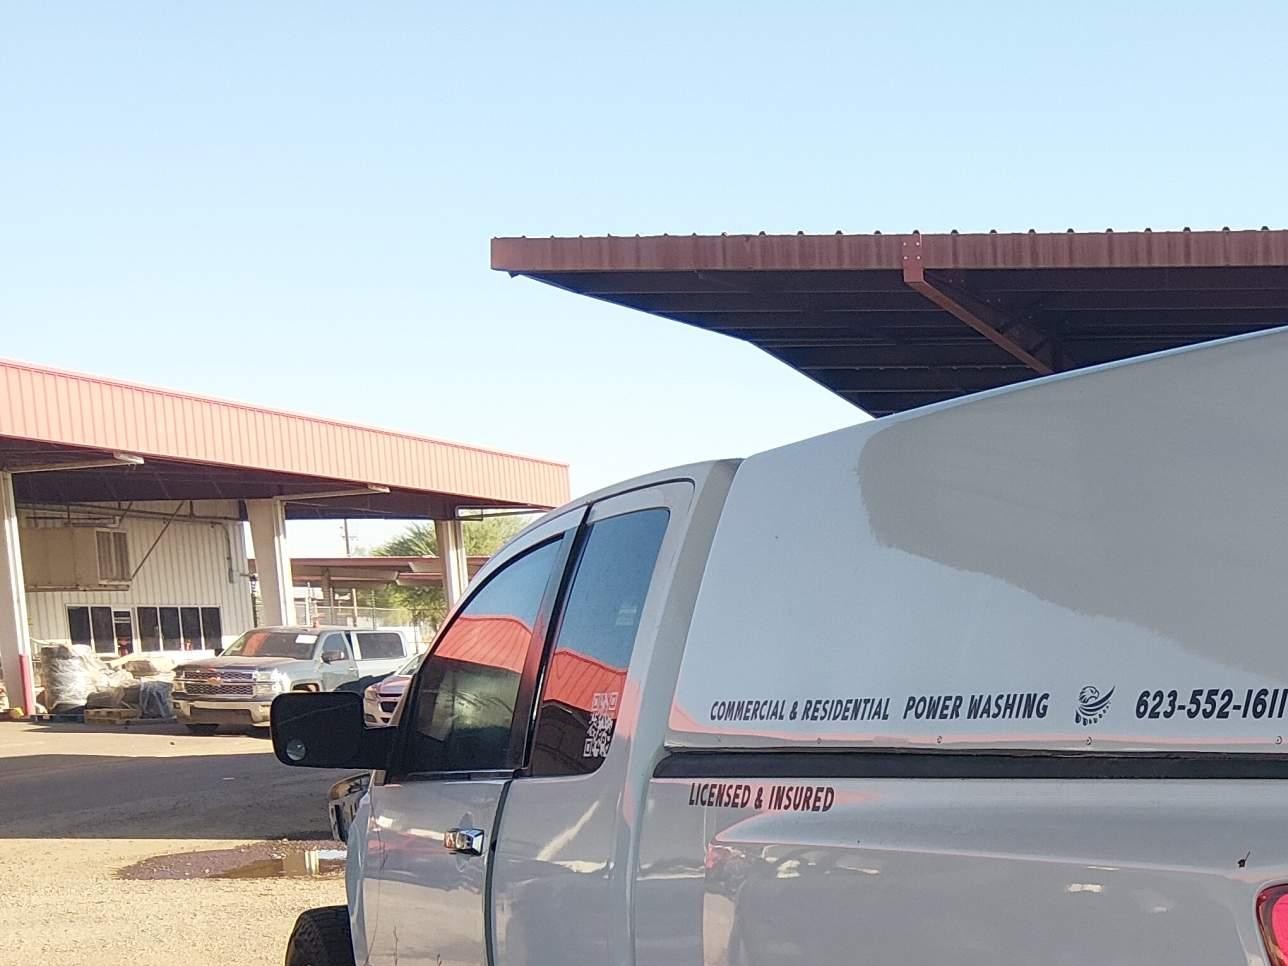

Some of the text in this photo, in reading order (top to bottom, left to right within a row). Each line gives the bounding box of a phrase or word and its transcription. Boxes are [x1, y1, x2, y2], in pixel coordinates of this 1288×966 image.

[710, 688, 1288, 721] COMMERCIAL & RESIDENTIAL POWER WASHING 623-552-1611
[688, 782, 835, 812] LICENSED & INSURED
